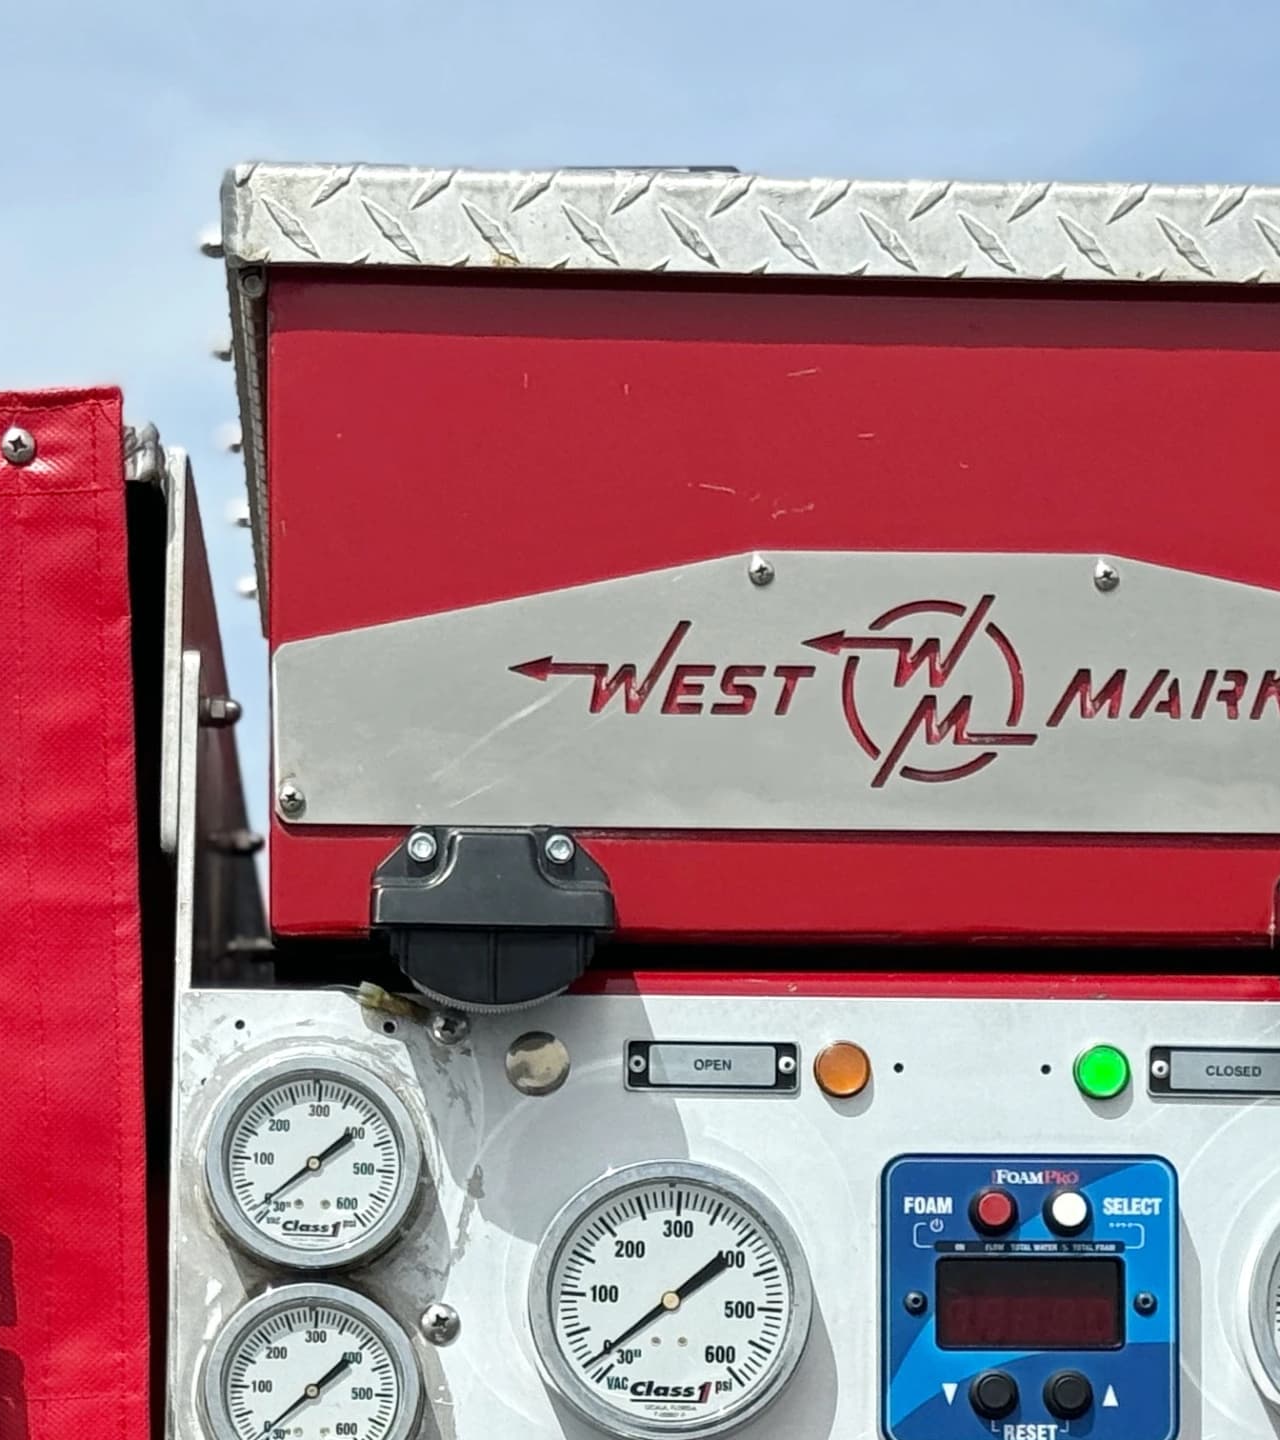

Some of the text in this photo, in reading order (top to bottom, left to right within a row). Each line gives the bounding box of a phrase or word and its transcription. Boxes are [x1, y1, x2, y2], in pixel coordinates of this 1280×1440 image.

[551, 620, 816, 716] WEST
[694, 1058, 732, 1071] OPEN
[1206, 1065, 1262, 1078] CLOSED
[308, 1104, 330, 1117] 300
[268, 1119, 290, 1132] 200
[254, 1152, 274, 1165] 100
[353, 1163, 374, 1175] 500
[336, 1197, 358, 1210] 600
[904, 1197, 953, 1214] FOAM
[1102, 1198, 1162, 1216] SELECT
[662, 1220, 694, 1238] 300
[614, 1240, 646, 1258] 200
[590, 1285, 618, 1302] 100
[724, 1301, 755, 1318] 500
[305, 1330, 327, 1343] 300
[265, 1347, 288, 1360] 200
[704, 1346, 736, 1364] 600
[252, 1380, 272, 1392] 100
[606, 1376, 628, 1390] VAC
[715, 1378, 732, 1394] psi
[352, 1388, 373, 1400] 500
[264, 1420, 272, 1433] 0
[336, 1422, 358, 1436] 600
